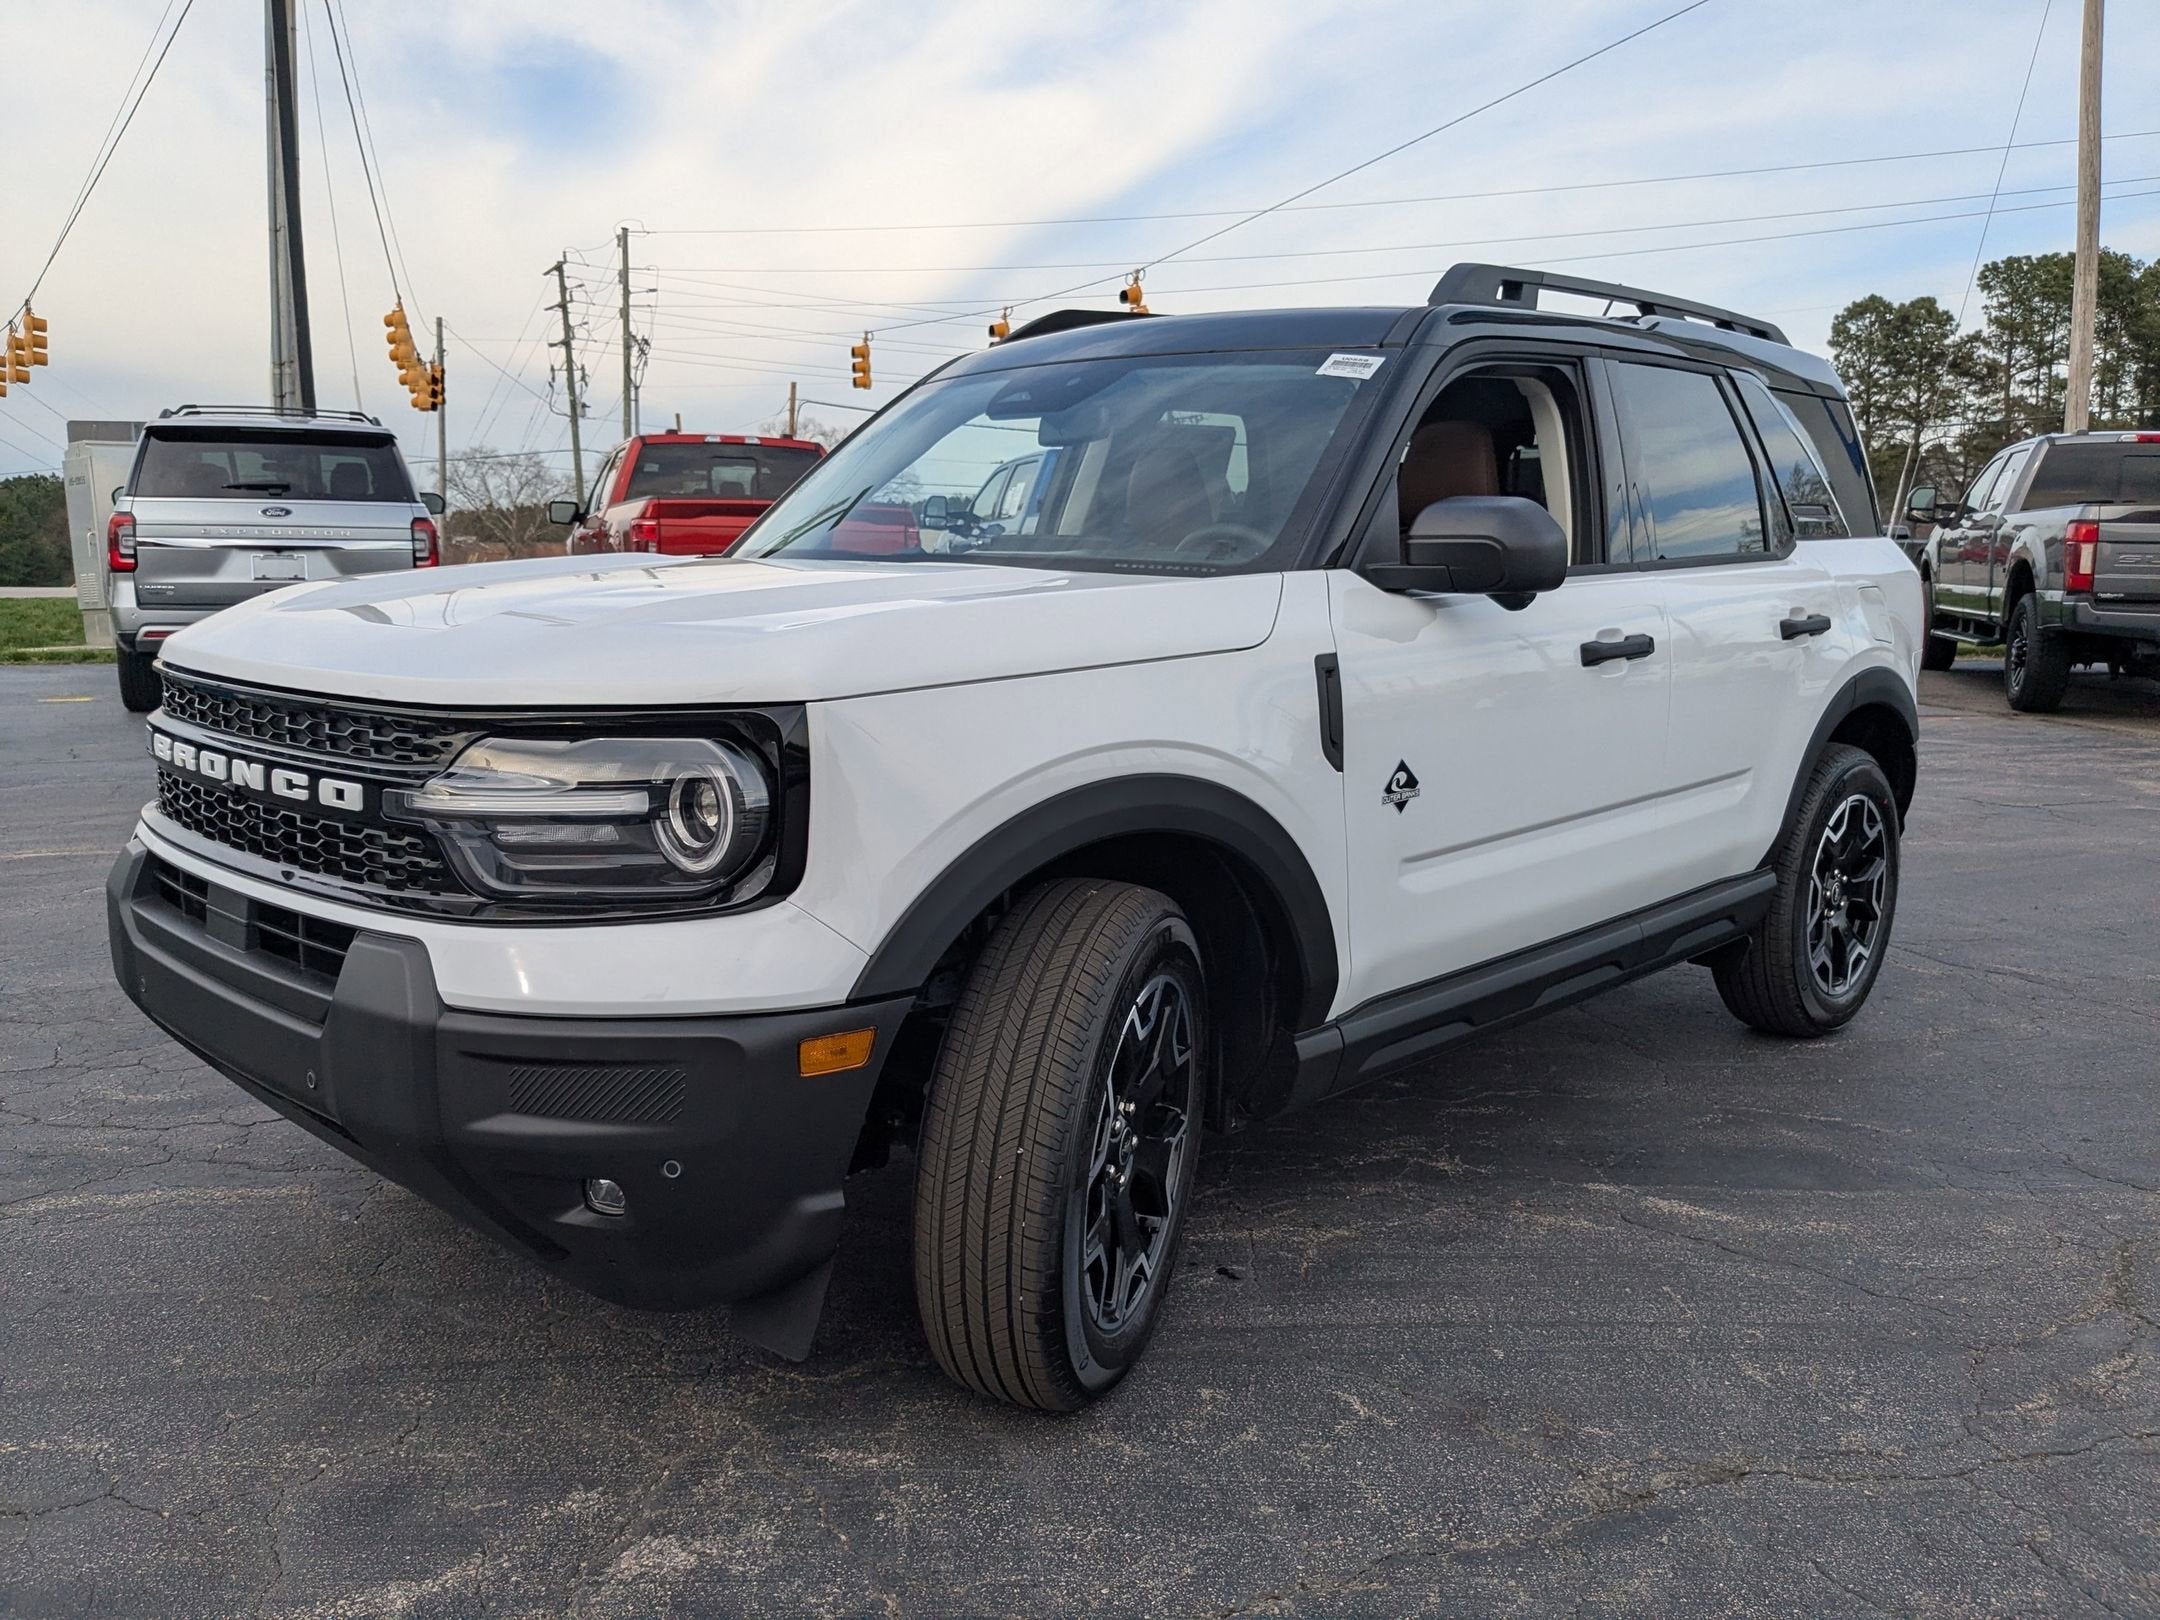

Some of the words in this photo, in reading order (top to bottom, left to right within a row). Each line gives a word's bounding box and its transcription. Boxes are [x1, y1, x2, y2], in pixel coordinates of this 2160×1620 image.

[264, 508, 288, 517] Ford
[200, 527, 351, 536] EXPEDITION
[153, 732, 363, 811] BRONCO
